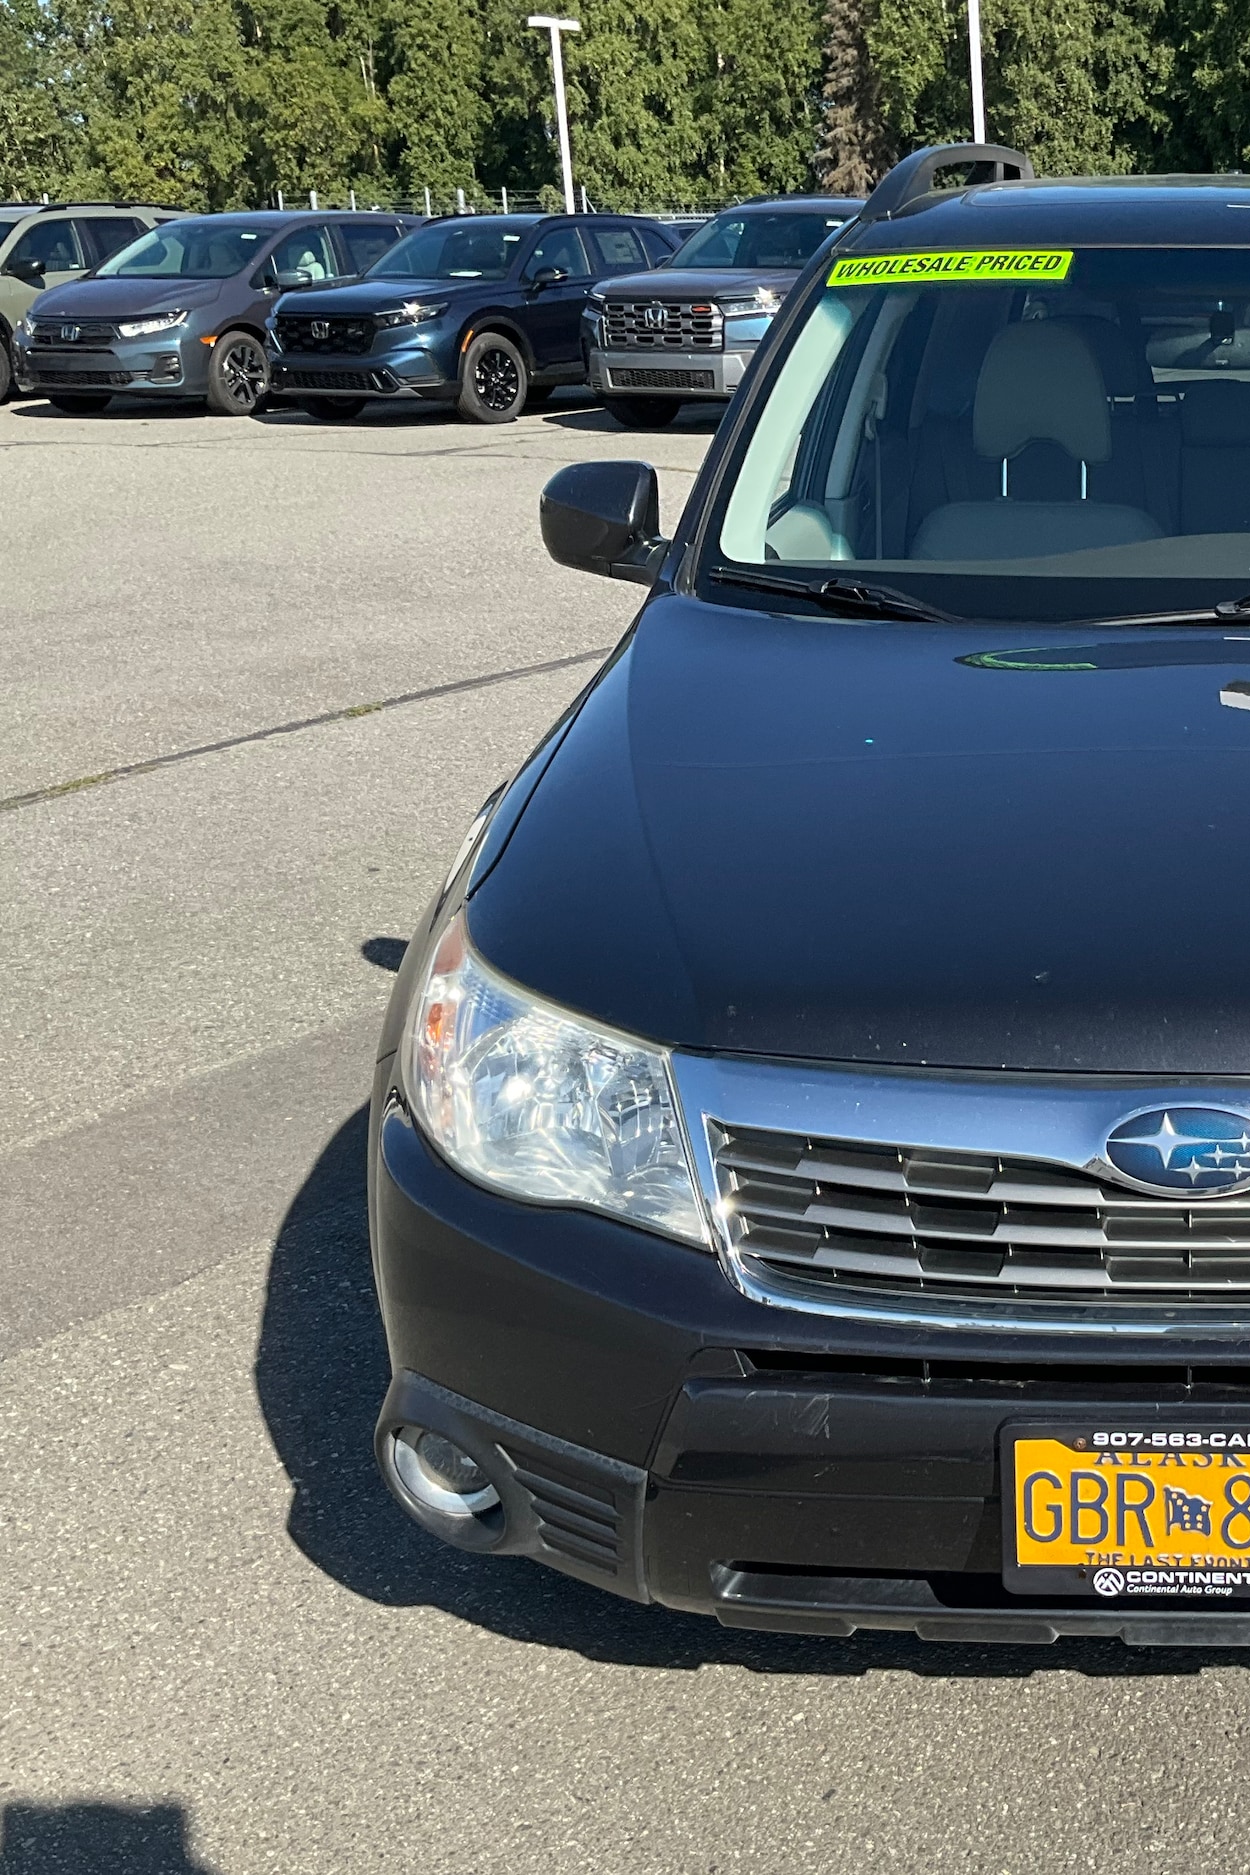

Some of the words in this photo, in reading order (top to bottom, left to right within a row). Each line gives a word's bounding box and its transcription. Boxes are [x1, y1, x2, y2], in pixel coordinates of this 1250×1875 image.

[836, 256, 973, 278] WHOLESALE
[973, 255, 1063, 272] PRICED
[1023, 1471, 1155, 1547] GBR
[1086, 1551, 1123, 1566] THE
[1130, 1553, 1184, 1567] LAST
[1126, 1584, 1179, 1594] Continental
[1179, 1585, 1203, 1595] Auto
[1204, 1585, 1233, 1597] Group
